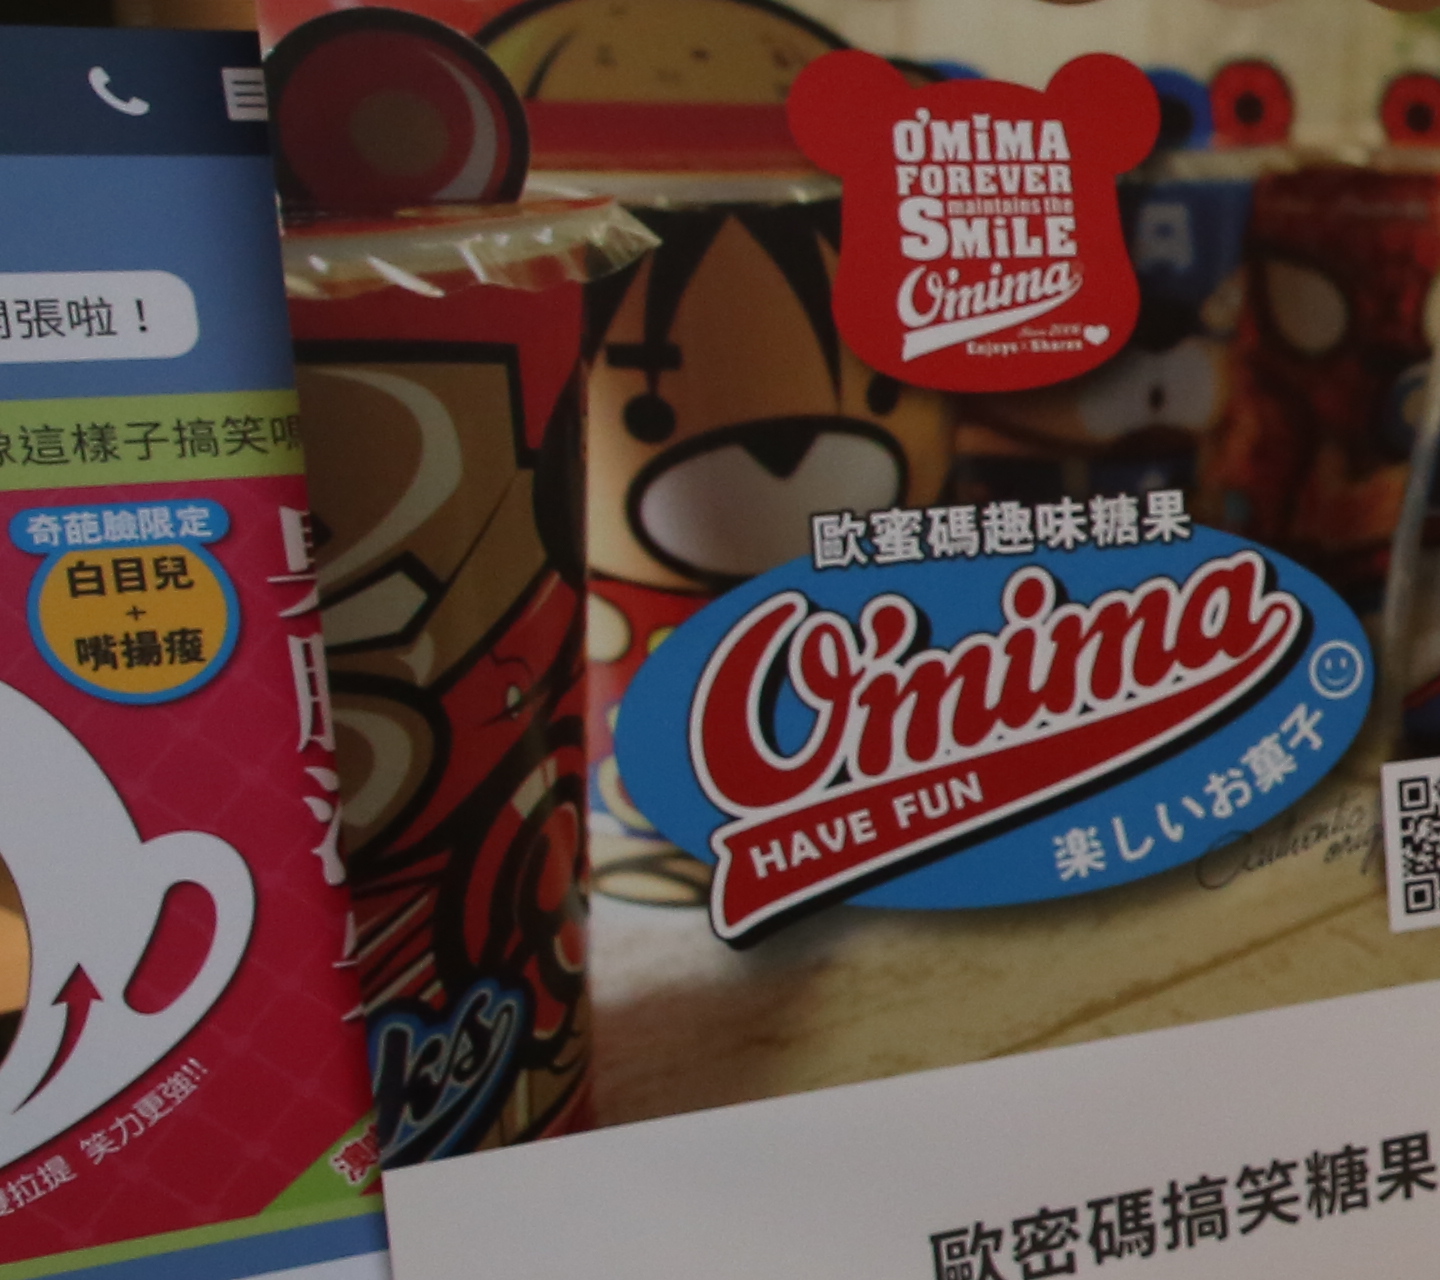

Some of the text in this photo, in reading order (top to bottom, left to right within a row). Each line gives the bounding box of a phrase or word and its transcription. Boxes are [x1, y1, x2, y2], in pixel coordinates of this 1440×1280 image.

[896, 163, 1073, 196] FOREVER
[947, 197, 1074, 216] maintains the
[897, 261, 1085, 330] O'mima
[26, 502, 215, 547] 奇葩臉限定
[811, 489, 1192, 568] 歐蜜碼趣味糖果
[66, 554, 195, 599] 白目兒
[689, 549, 1308, 818] O'mima
[748, 771, 984, 882] HAVE FUN
[1051, 701, 1329, 883] 楽しいお菓子
